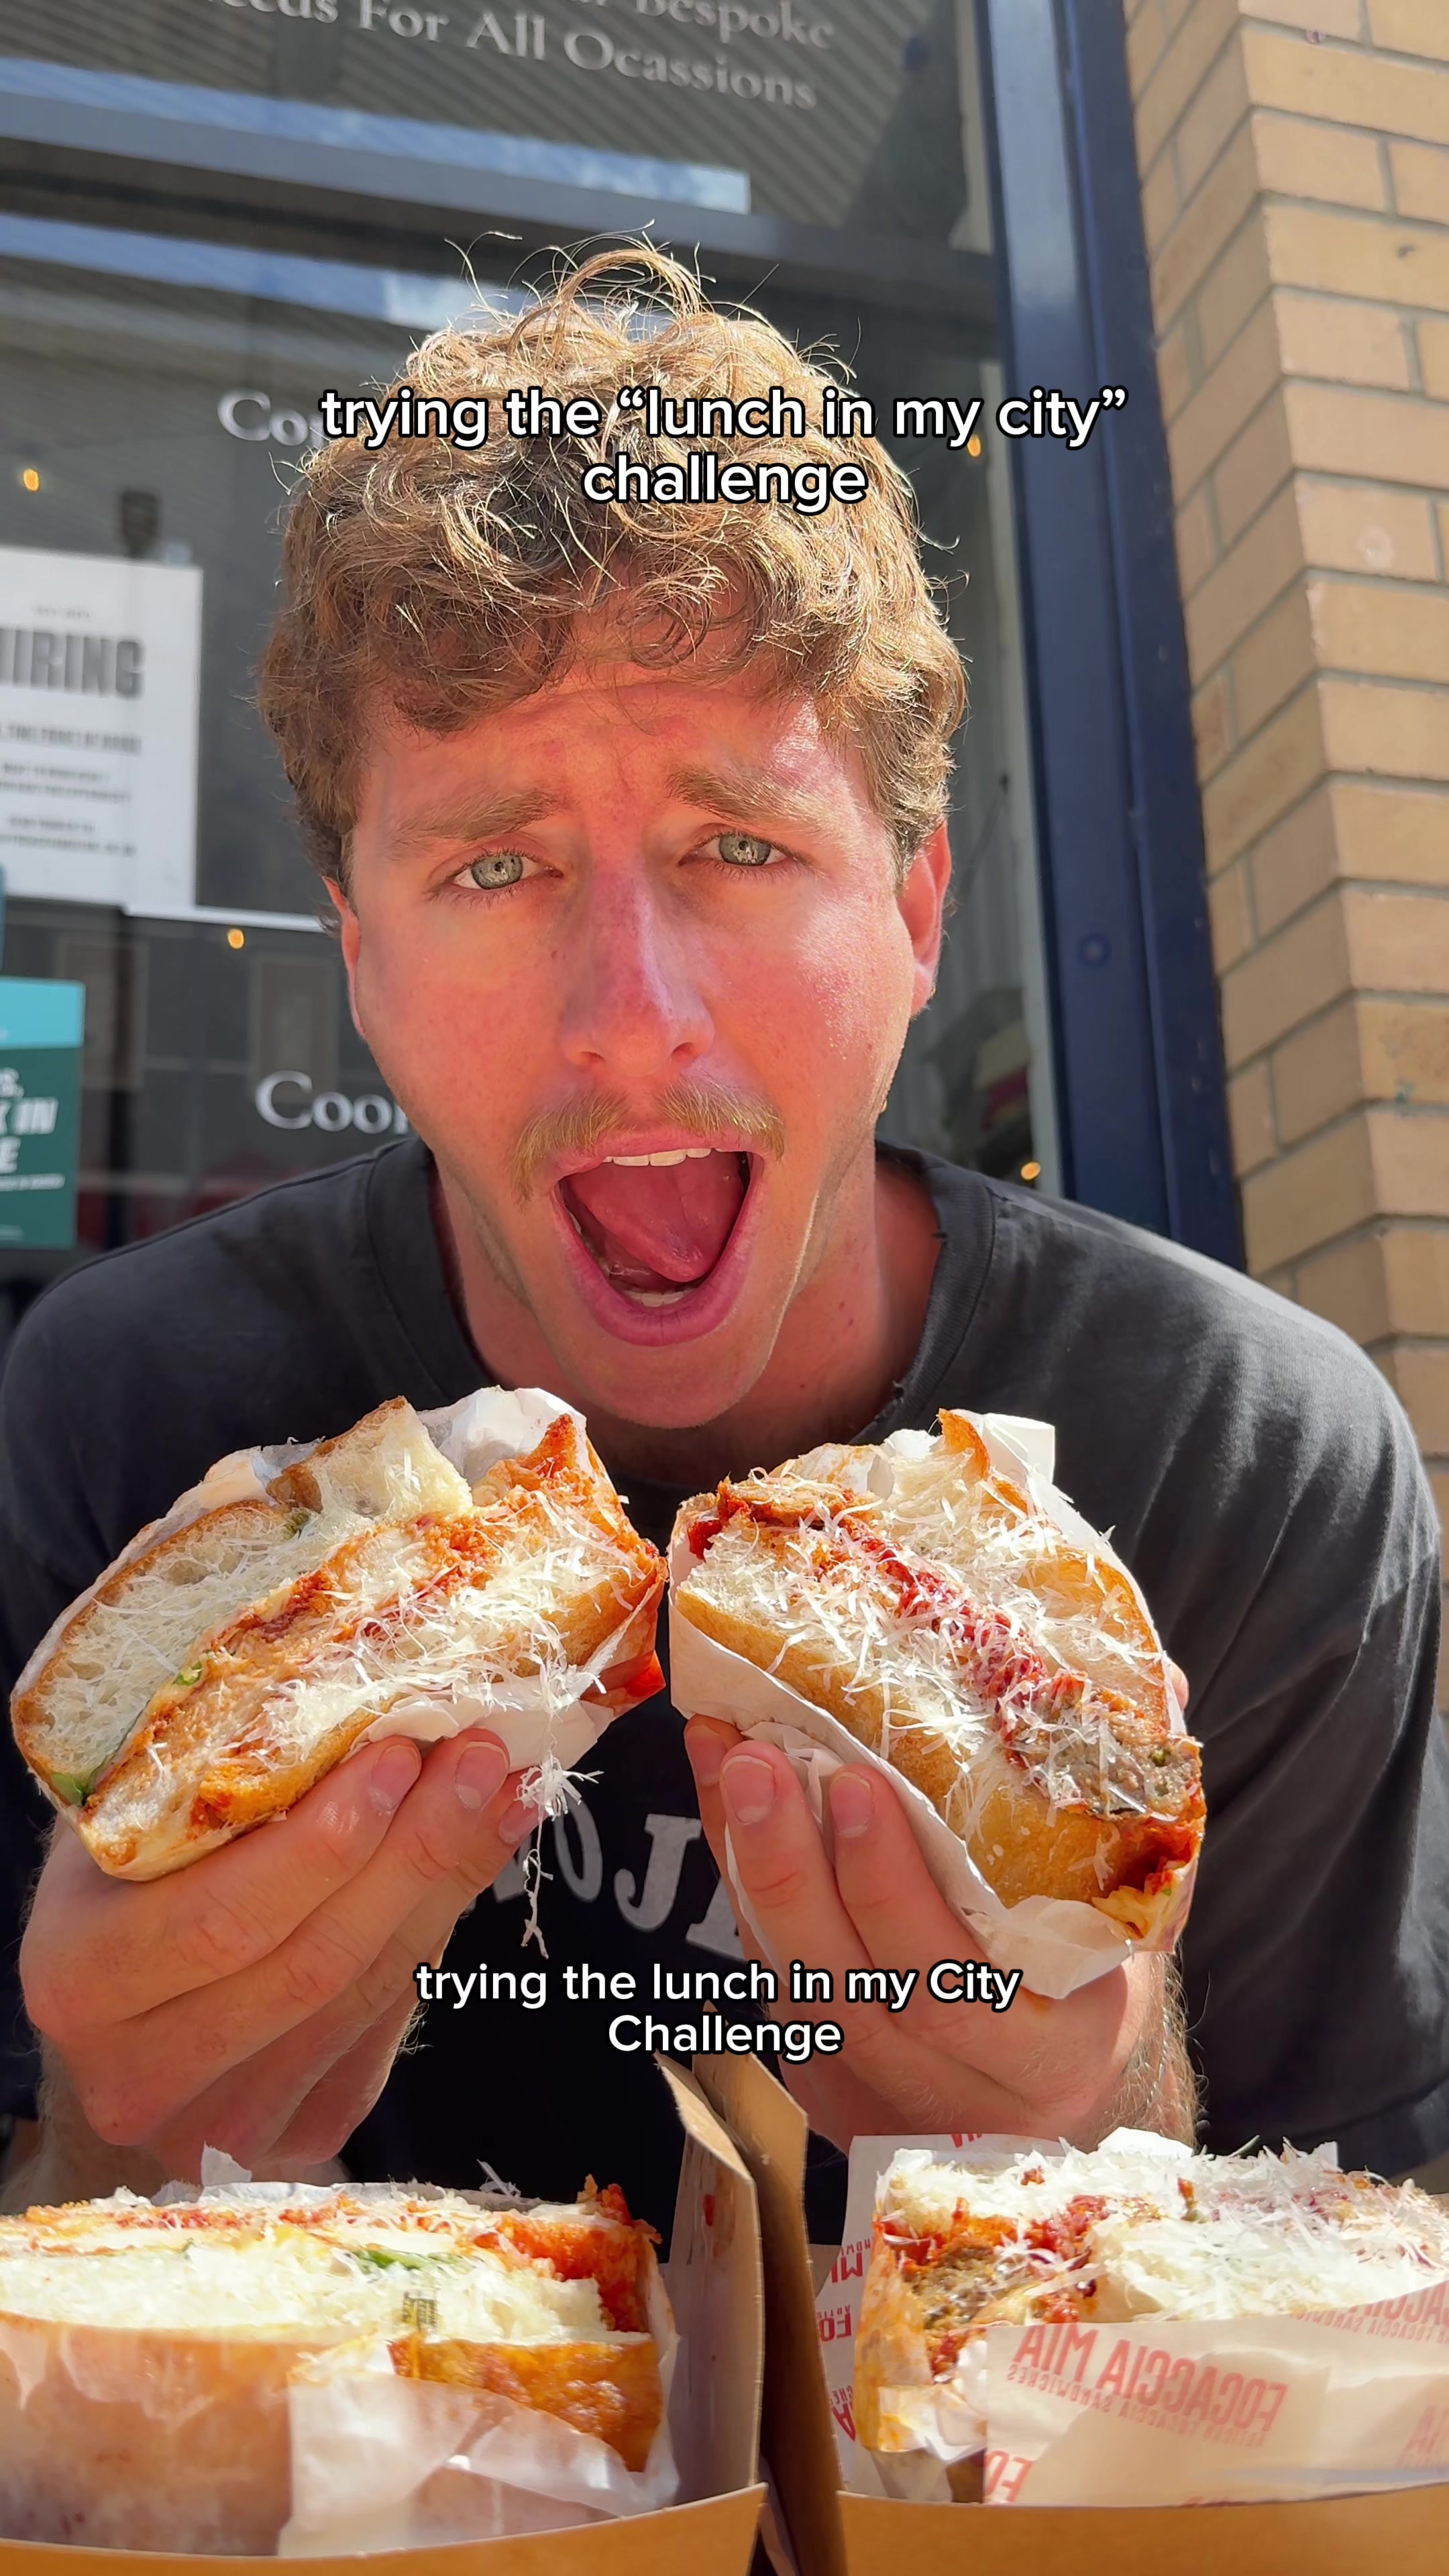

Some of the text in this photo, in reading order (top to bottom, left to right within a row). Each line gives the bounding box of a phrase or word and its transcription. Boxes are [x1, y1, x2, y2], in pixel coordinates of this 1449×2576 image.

[359, 0, 450, 42] For
[466, 10, 545, 60] All
[564, 27, 817, 110] Ocassions
